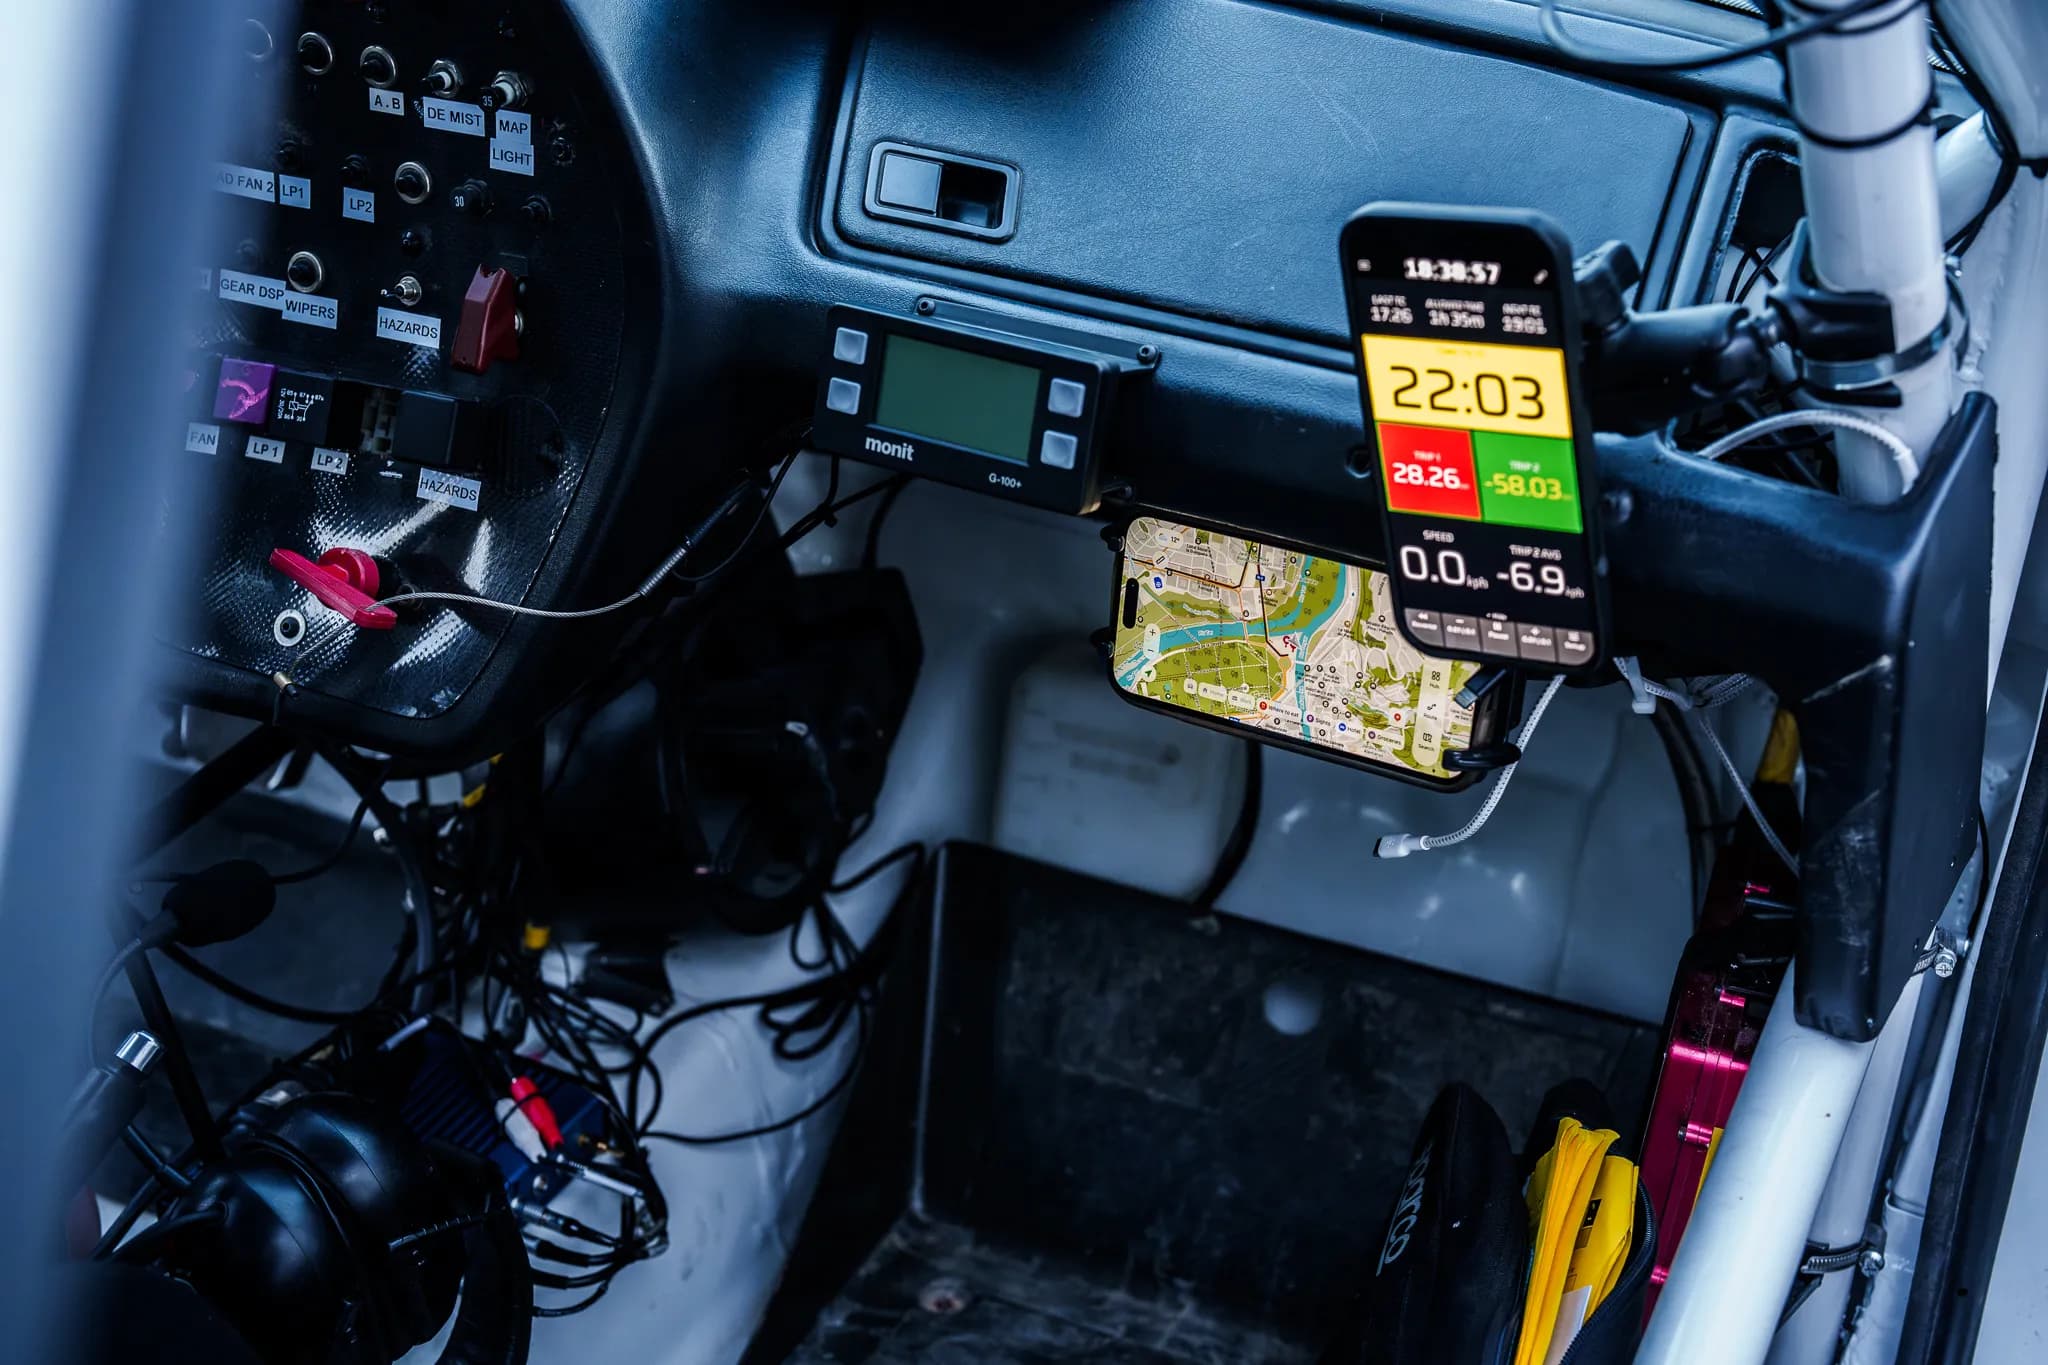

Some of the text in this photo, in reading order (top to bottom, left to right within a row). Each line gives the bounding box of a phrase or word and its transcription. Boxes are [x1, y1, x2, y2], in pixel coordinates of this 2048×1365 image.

[374, 95, 401, 110] A.B
[482, 95, 493, 107] 35
[428, 107, 446, 121] DE
[450, 110, 482, 127] MIST
[500, 120, 528, 135] MAP
[492, 148, 532, 166] LIGHT
[238, 175, 263, 191] FAN
[266, 181, 274, 193] 2
[282, 186, 303, 199] LP1
[350, 198, 372, 213] LP2
[454, 195, 465, 207] 30
[220, 278, 255, 295] GEAR
[259, 286, 285, 300] DSP
[285, 299, 336, 320] WIPERS
[379, 316, 438, 339] HAZARDS
[1390, 365, 1545, 420] 22:03
[190, 431, 216, 446] FAN
[253, 442, 279, 458] LP 1
[865, 436, 914, 461] monit
[317, 454, 344, 469] LP 2
[988, 472, 1022, 488] G-100+
[1392, 462, 1460, 490] 28.26
[420, 477, 477, 501] HAZARDS
[1484, 472, 1562, 500] -58.03
[1422, 529, 1455, 543] SPEED
[1508, 544, 1532, 557] TRIP
[1401, 545, 1465, 586] 0.0
[1496, 561, 1565, 596] -6.9
